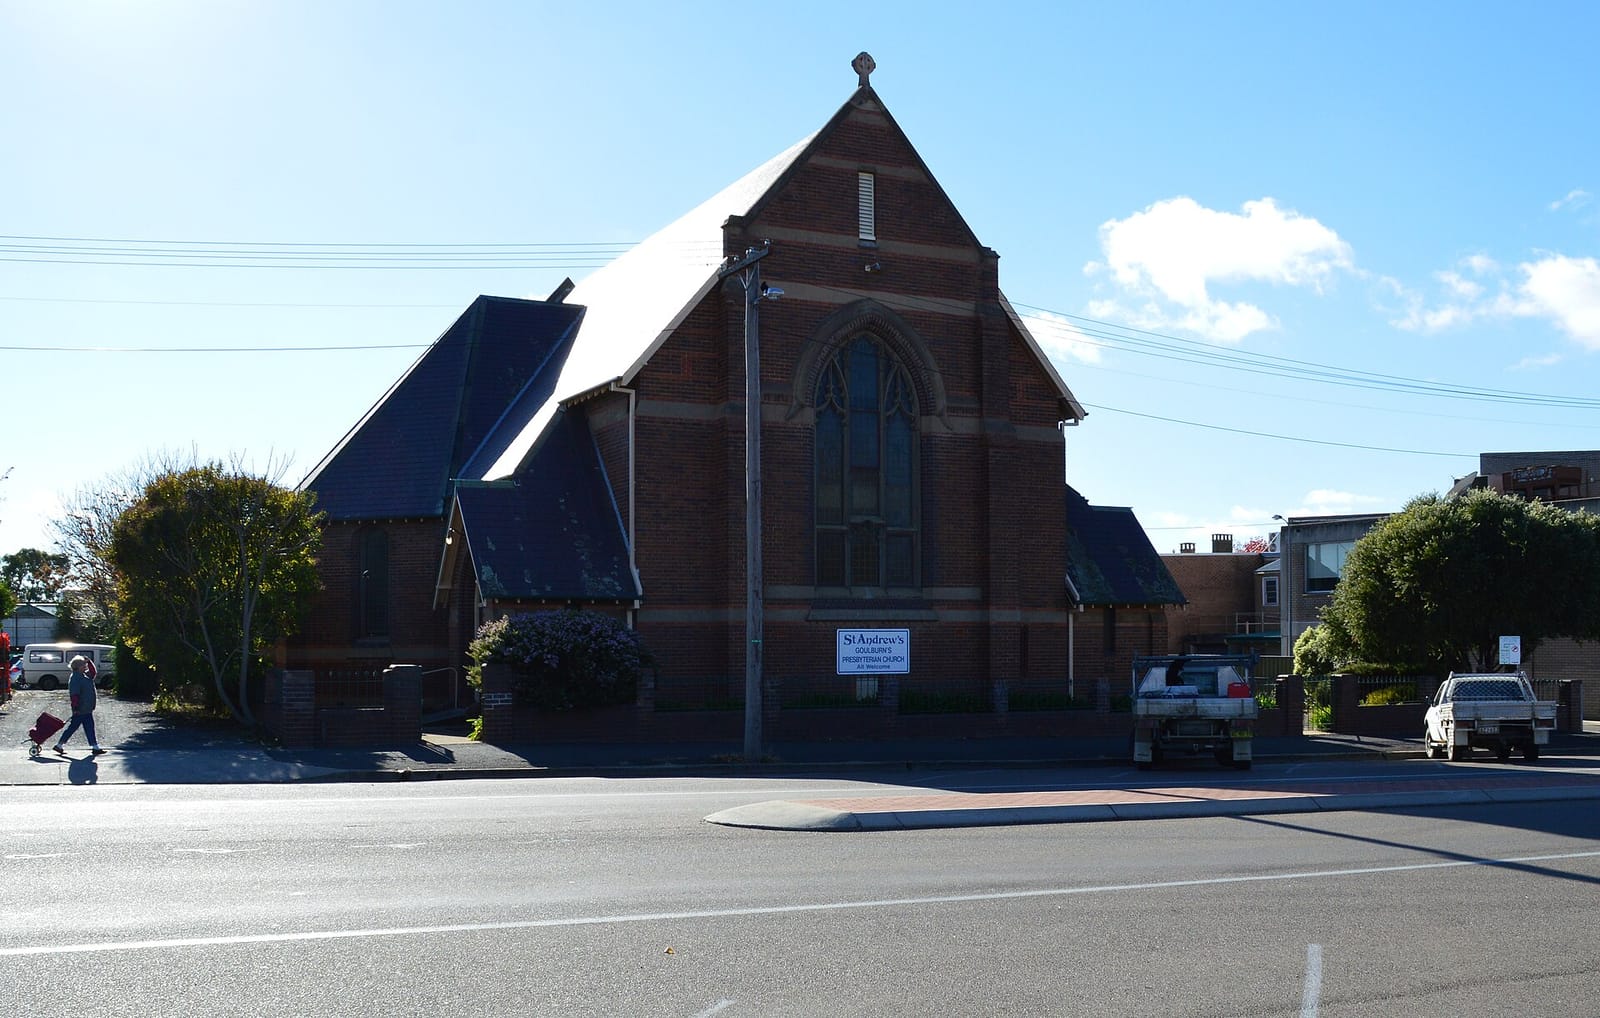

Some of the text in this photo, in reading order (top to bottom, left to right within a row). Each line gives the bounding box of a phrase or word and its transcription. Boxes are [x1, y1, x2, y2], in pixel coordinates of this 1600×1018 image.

[843, 633, 905, 646] St Andrew's
[854, 646, 893, 654] GOULBURN'S
[882, 655, 905, 663] CHURCH
